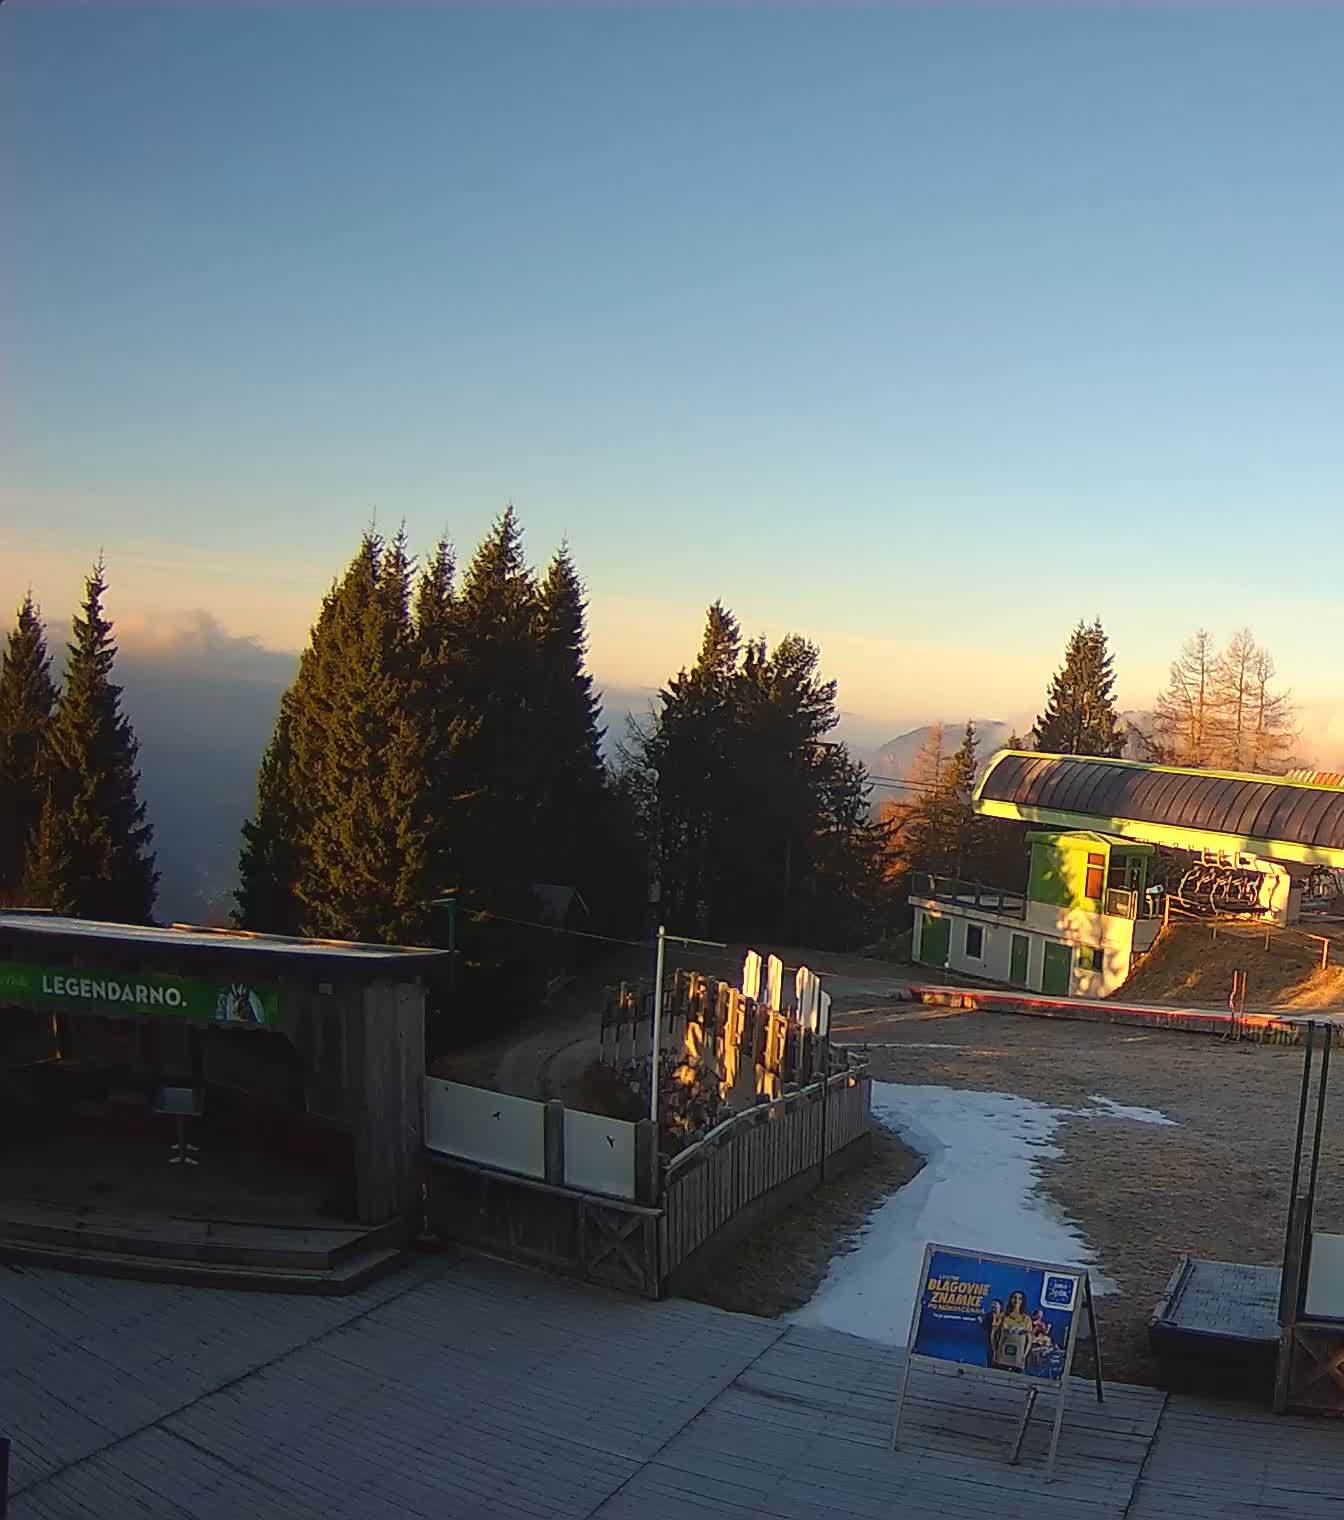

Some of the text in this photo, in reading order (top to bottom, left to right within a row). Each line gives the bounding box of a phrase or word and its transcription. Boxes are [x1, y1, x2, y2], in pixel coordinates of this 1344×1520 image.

[42, 975, 187, 1007] LEGENDARNO.
[928, 1278, 991, 1296] BLAGOVNE
[930, 1292, 984, 1307] ZNAMKE
